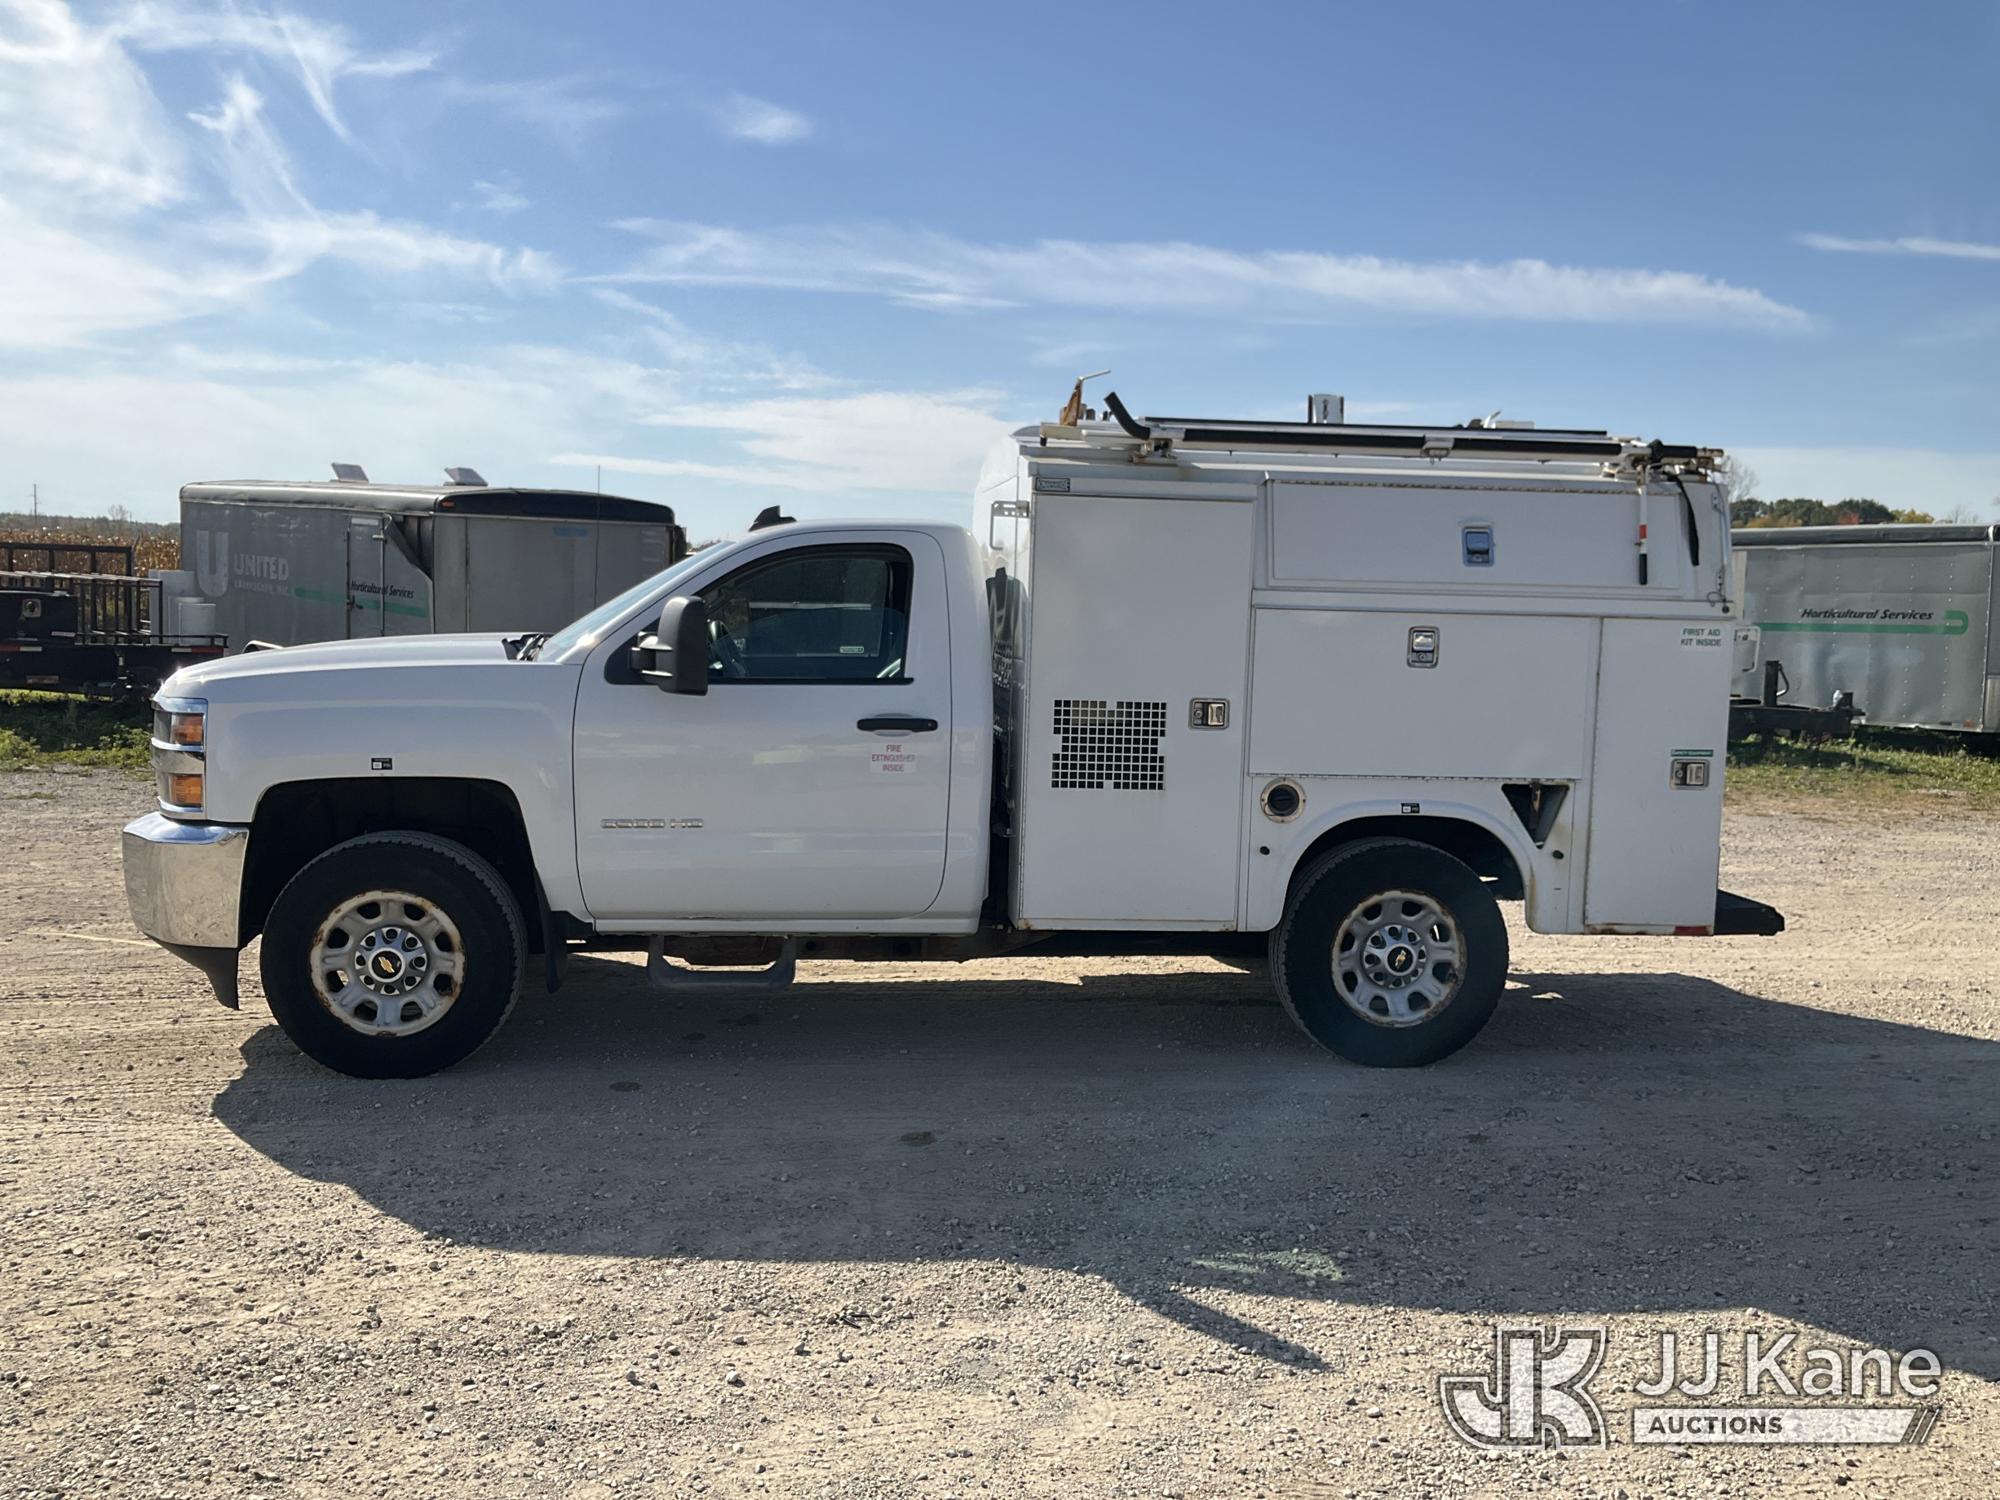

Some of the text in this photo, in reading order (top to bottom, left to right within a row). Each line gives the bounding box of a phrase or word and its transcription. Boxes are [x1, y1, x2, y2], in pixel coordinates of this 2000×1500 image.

[197, 530, 229, 597] U
[233, 552, 289, 581] UNITED
[388, 585, 415, 599] Services
[1801, 608, 1934, 620] Horticultural Services
[1682, 628, 1721, 637] FIRST AID
[1681, 638, 1721, 647] KIT INSIDE
[886, 744, 902, 753] FIRE
[882, 763, 905, 772] INSIDE
